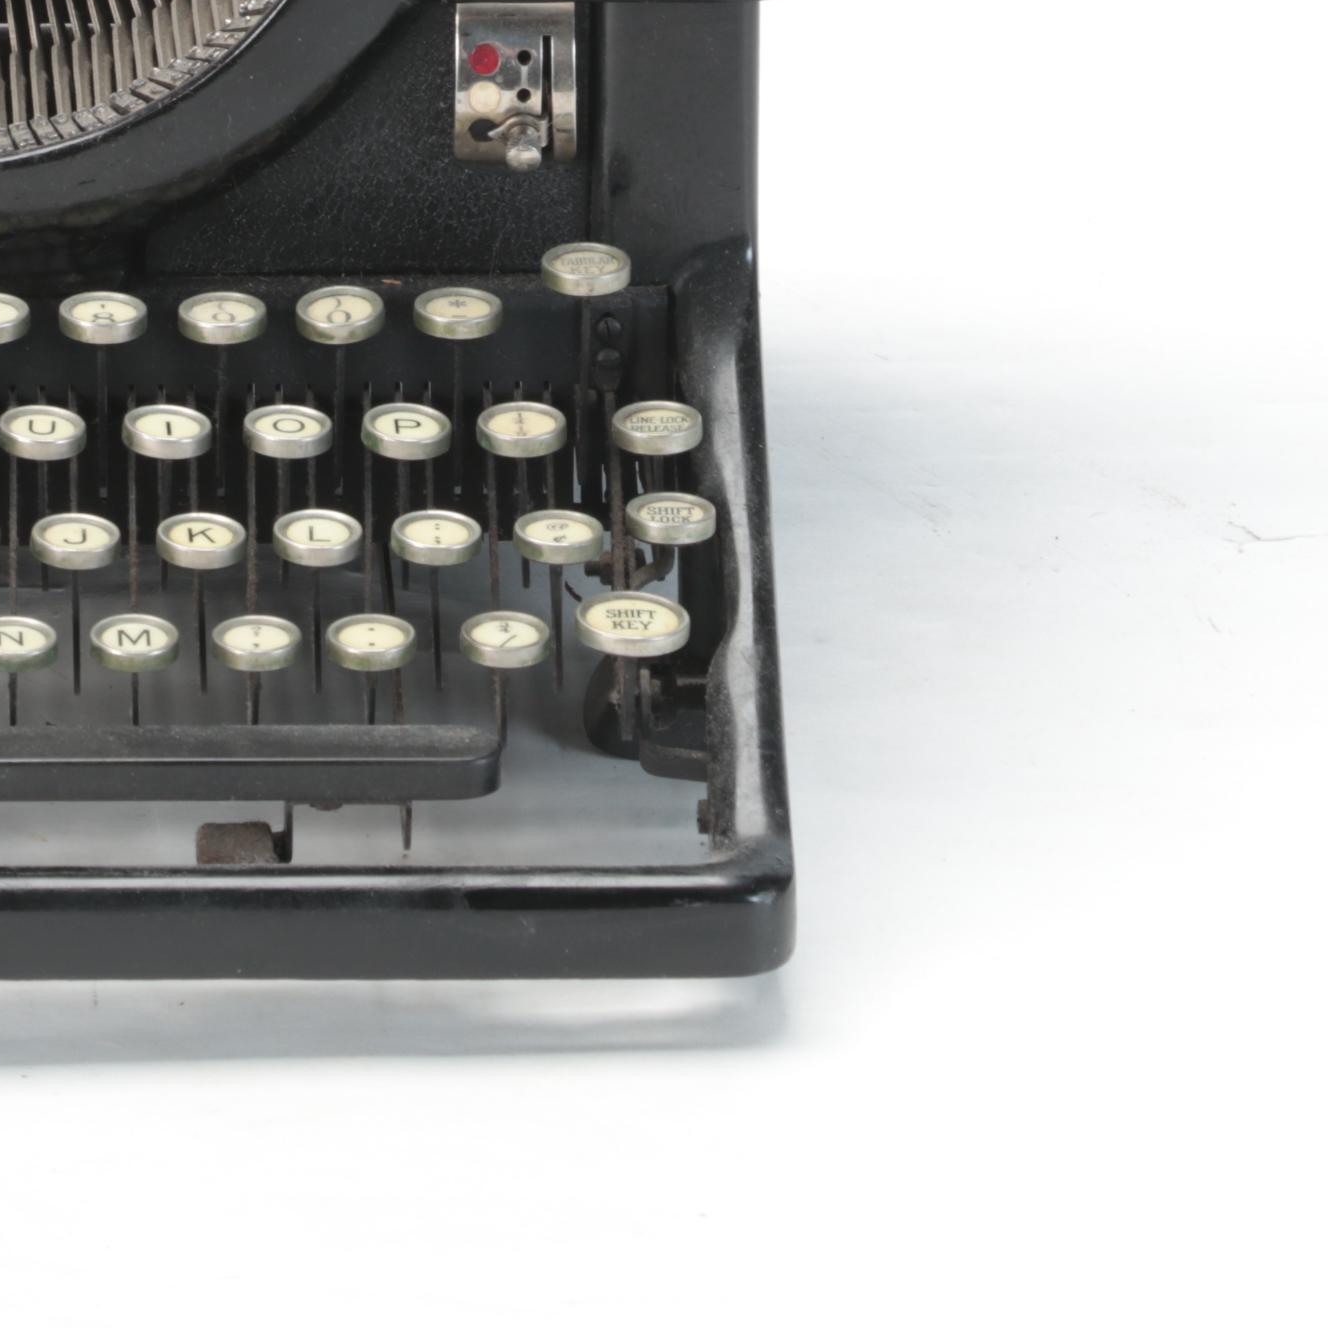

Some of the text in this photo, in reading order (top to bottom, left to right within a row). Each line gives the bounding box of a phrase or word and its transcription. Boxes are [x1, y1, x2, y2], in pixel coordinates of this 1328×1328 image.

[27, 418, 56, 436] U
[165, 420, 172, 436] I
[272, 417, 305, 434] O
[393, 418, 422, 435] P
[646, 506, 696, 517] SHIFT
[648, 515, 693, 524] LOCK
[63, 527, 88, 545] J
[186, 526, 217, 544] K
[308, 525, 332, 543] L
[605, 608, 657, 621] SHIFT
[612, 620, 654, 632] KEY
[117, 628, 152, 648] M
